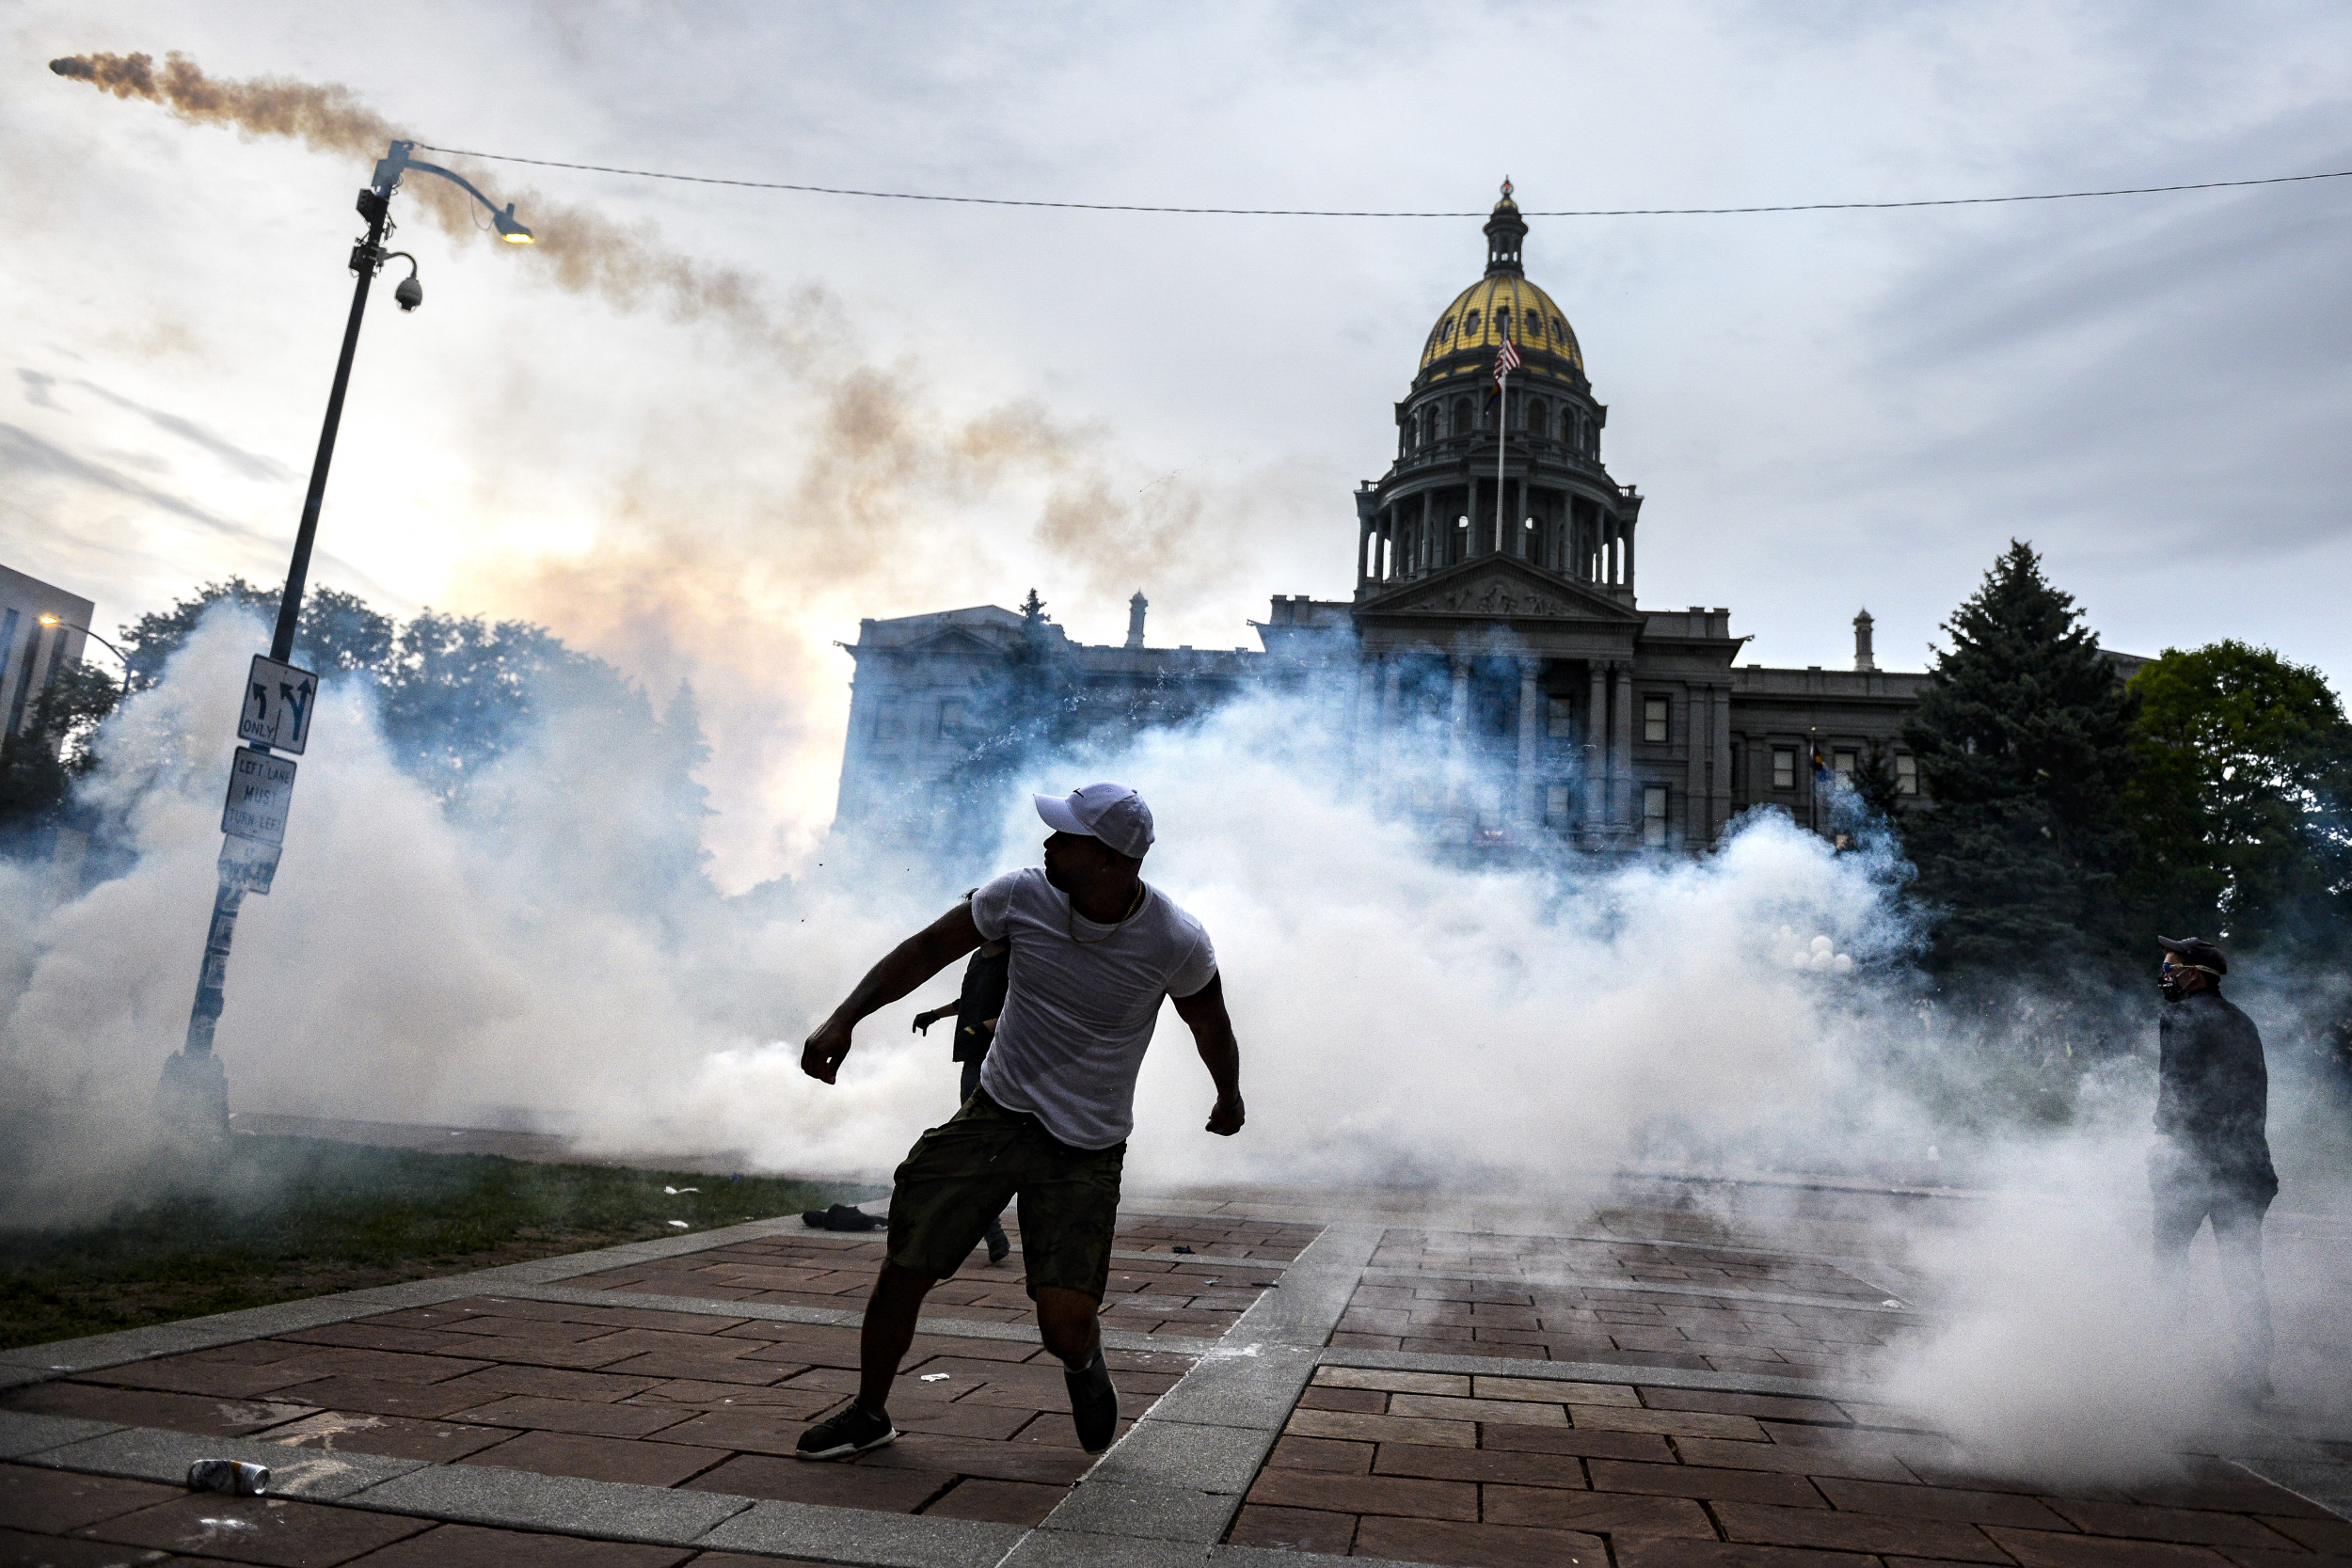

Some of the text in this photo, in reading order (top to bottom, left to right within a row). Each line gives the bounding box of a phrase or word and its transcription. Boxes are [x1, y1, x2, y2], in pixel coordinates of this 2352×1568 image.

[244, 719, 275, 738] ONLY
[239, 759, 291, 784] LEFT LANE
[244, 784, 277, 805] MUST
[229, 809, 255, 826] TURN
